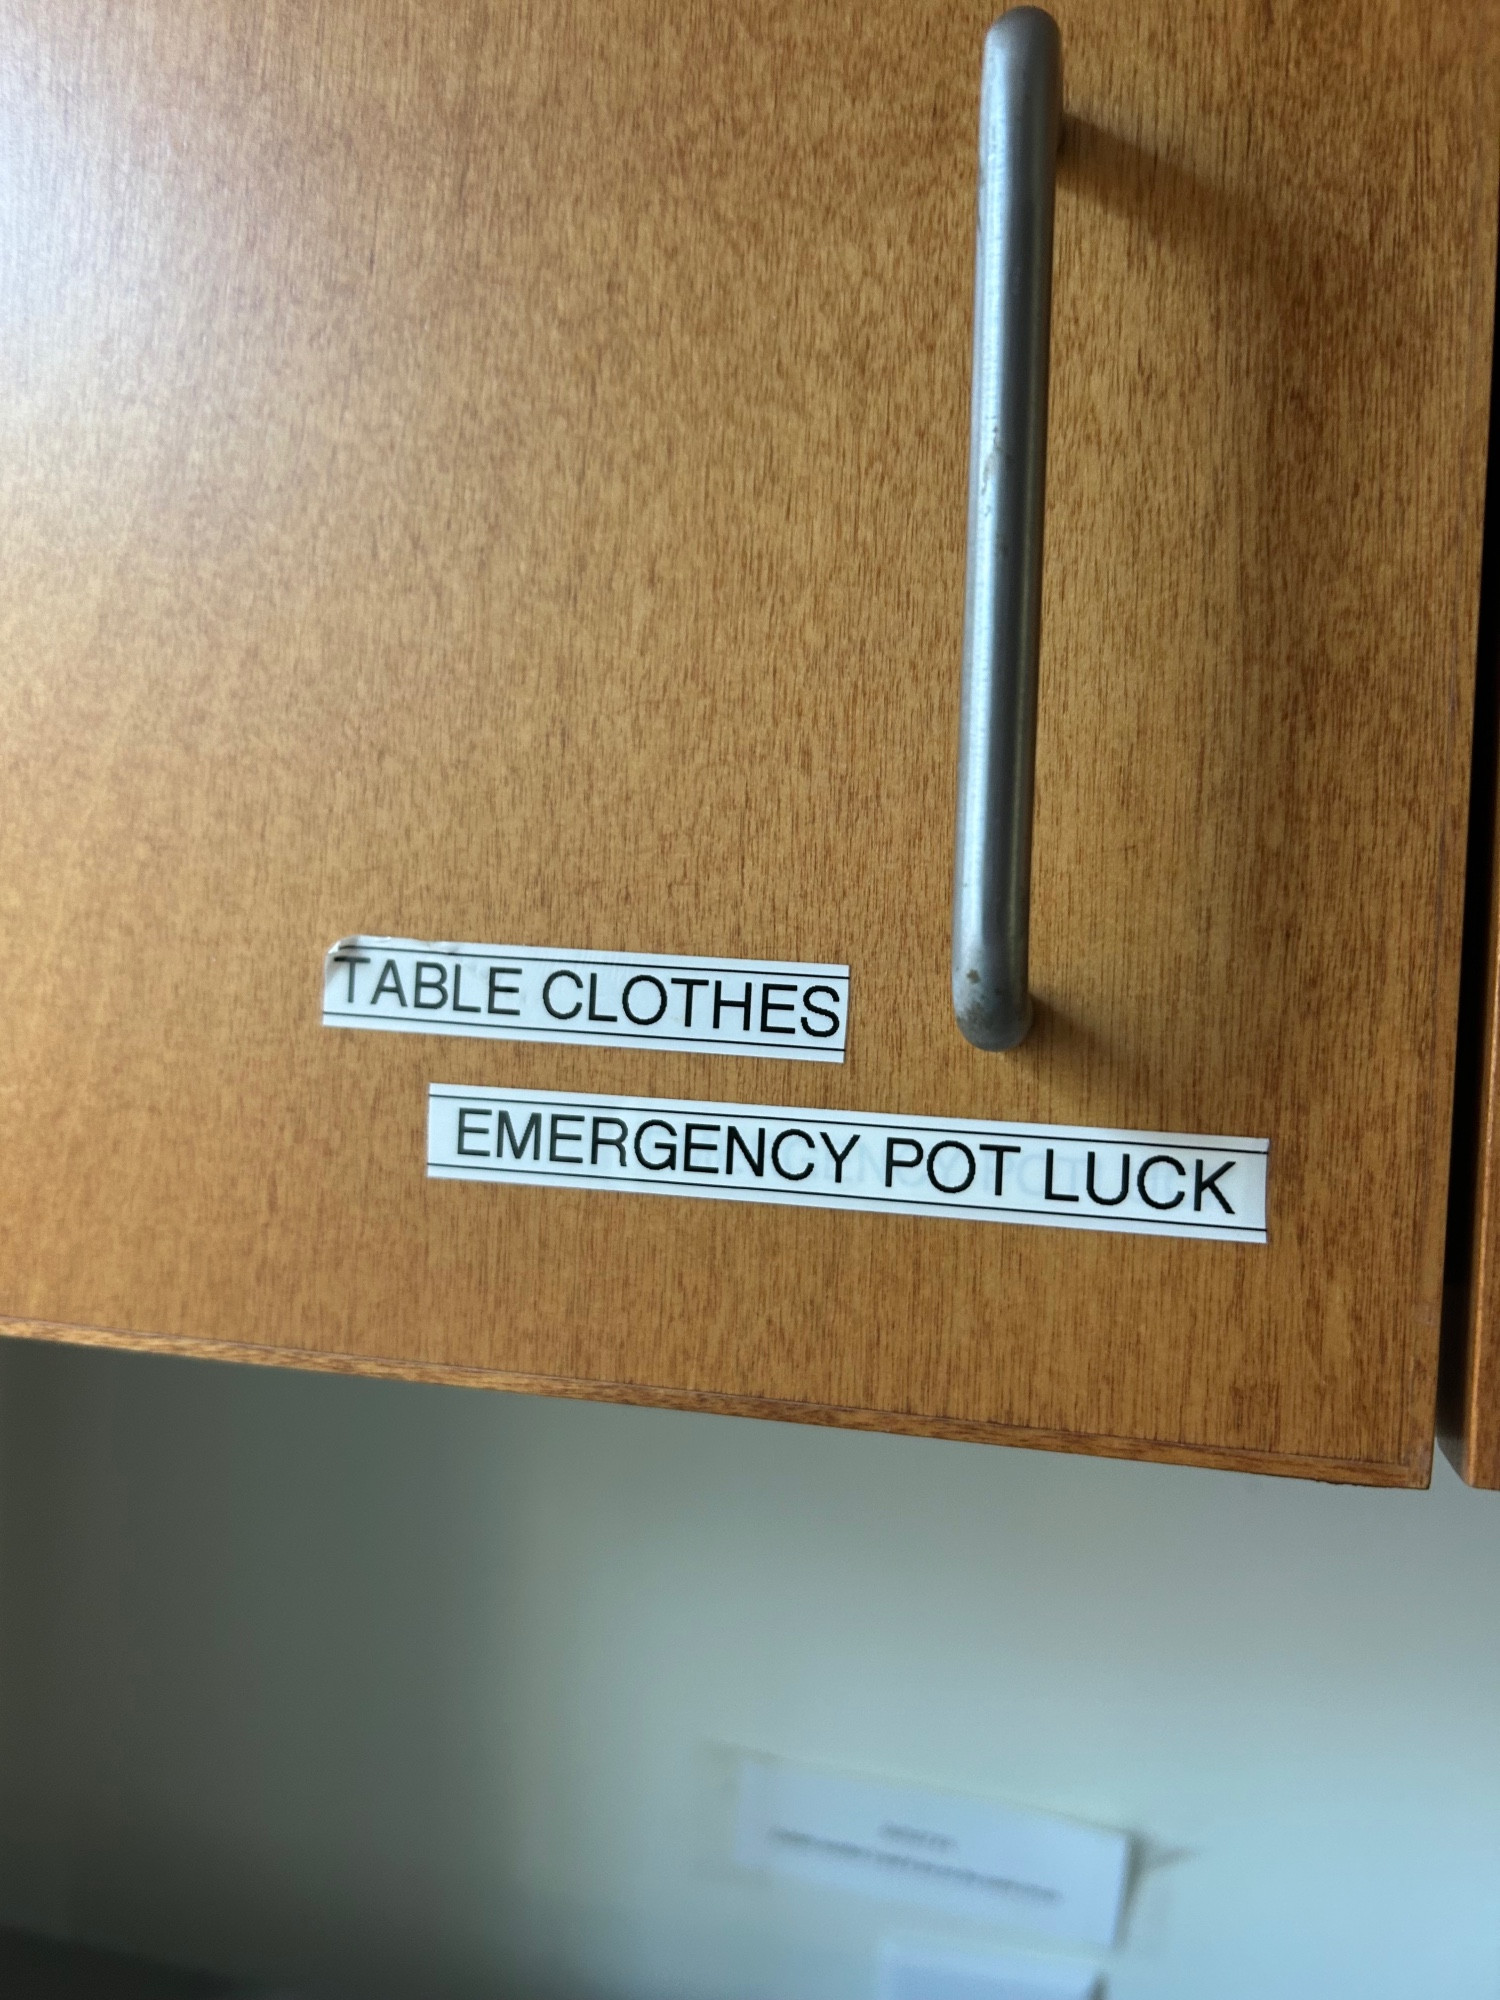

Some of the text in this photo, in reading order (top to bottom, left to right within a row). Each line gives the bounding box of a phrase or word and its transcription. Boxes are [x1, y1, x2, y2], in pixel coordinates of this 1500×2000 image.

[333, 956, 840, 1038] TABLE CLOTHES
[456, 1107, 1236, 1215] EMERGENCY POT LUCK
